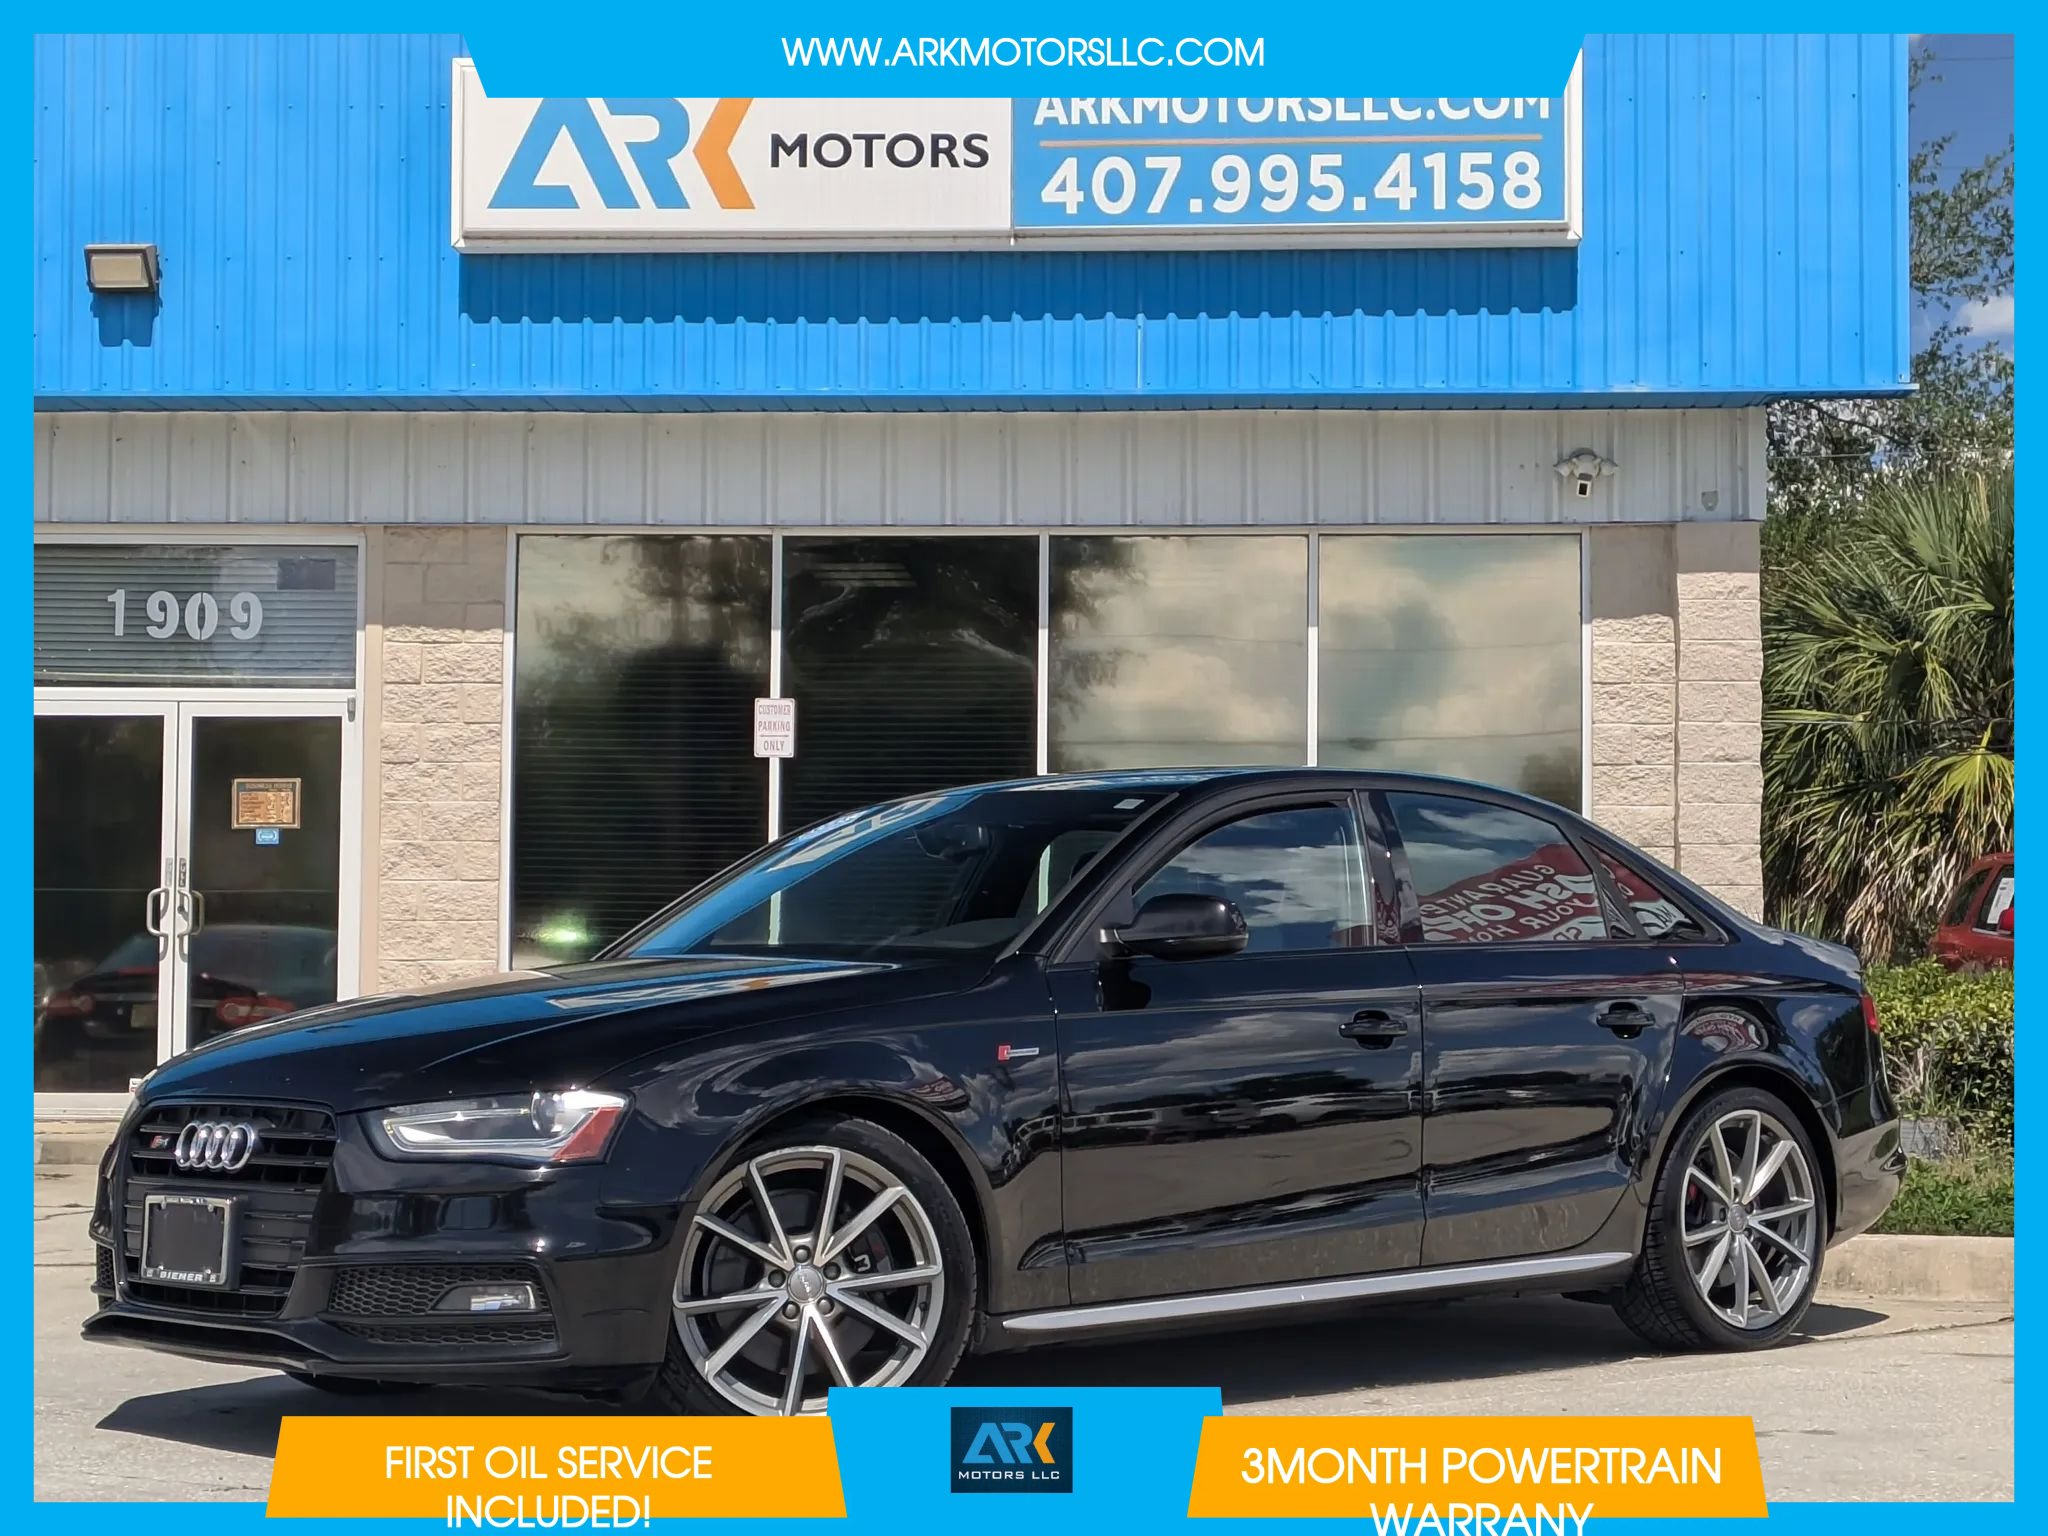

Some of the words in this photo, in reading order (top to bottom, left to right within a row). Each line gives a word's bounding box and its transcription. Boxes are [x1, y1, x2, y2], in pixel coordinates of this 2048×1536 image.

[488, 98, 754, 210] ARK
[770, 132, 989, 169] MOTORS
[1041, 152, 1543, 214] 407.995.4158
[107, 589, 263, 641] 1909
[758, 721, 791, 732] PARKING
[759, 704, 791, 715] CUSTOMER
[763, 740, 785, 752] ONLY
